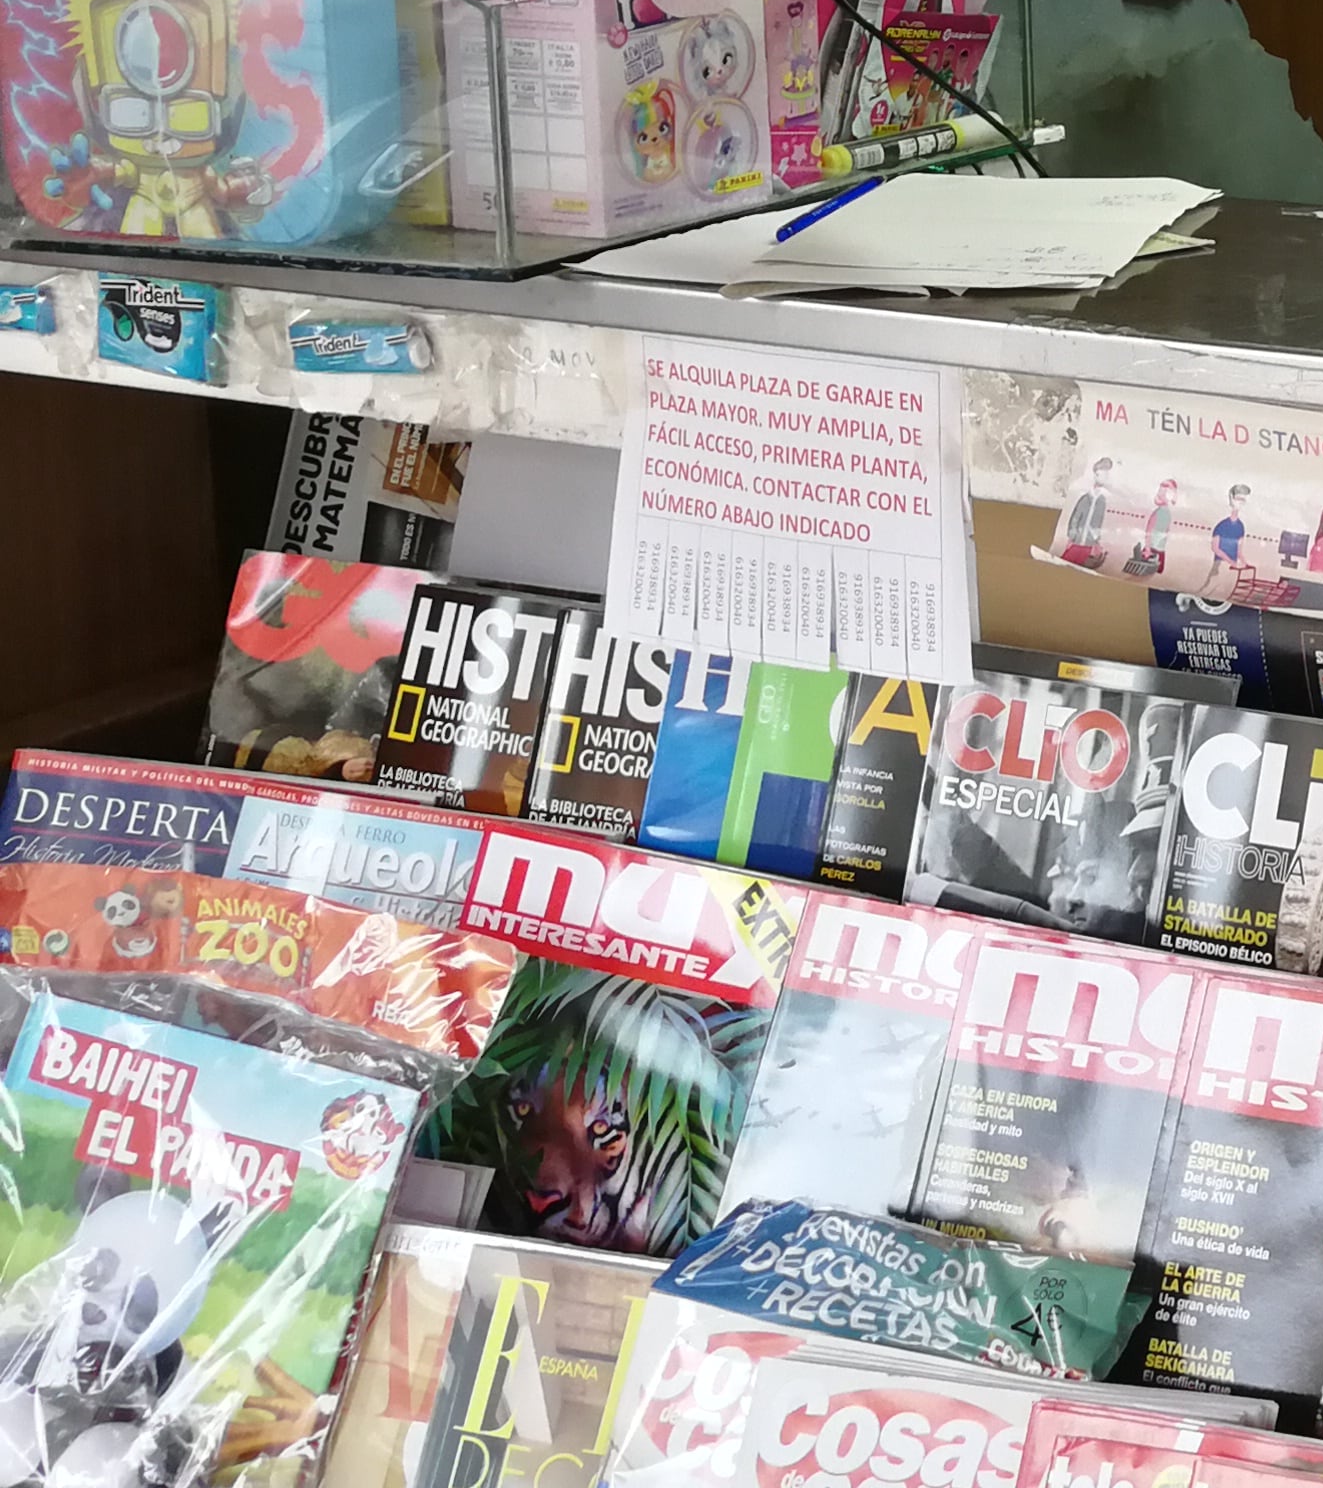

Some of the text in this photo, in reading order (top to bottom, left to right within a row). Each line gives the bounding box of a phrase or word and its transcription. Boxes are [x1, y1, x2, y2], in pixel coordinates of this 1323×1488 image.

[125, 285, 182, 305] Trident
[648, 358, 923, 412] SE ALQUILA PLAZA DE GARAJE EN
[650, 391, 923, 446] PLAZA MAYOR. MUY AMPLIA, DE
[648, 420, 929, 484] FÁCIL ACCESO, PRIMERA PLANTA,
[644, 458, 932, 516] ECONÓMICA. CONTACTAR CON EL
[642, 488, 871, 543] NÚMERO ABAJO INDICADO
[1182, 627, 1229, 644] YA PUEDES
[427, 694, 512, 730] NATIONAL
[420, 719, 533, 758] GEOGRAPHIC
[380, 764, 464, 793] LA BIBLIOTECA
[14, 787, 231, 846] DESPERTA
[938, 776, 1079, 827] ESPECIAL
[196, 899, 308, 938] ANIMALES
[1167, 896, 1277, 930] LA BATALLA DE
[196, 919, 299, 978] ZOO
[466, 907, 711, 982] INTERESANTE
[1164, 915, 1269, 948] STALINGRADO
[1160, 934, 1273, 966] EL EPISODIO BÉLICO
[42, 1027, 187, 1113] BAIHEI
[1187, 1155, 1270, 1182] ESPLENDOR
[1172, 1232, 1270, 1261] Una ética de vida
[1161, 1277, 1241, 1303] LA GUERRA
[1164, 1263, 1246, 1288] EL ARTE DE
[539, 1355, 599, 1382] ESPAÑA
[1145, 1354, 1235, 1383] SEKIGAHARA
[1148, 1338, 1232, 1365] BATALLA DE
